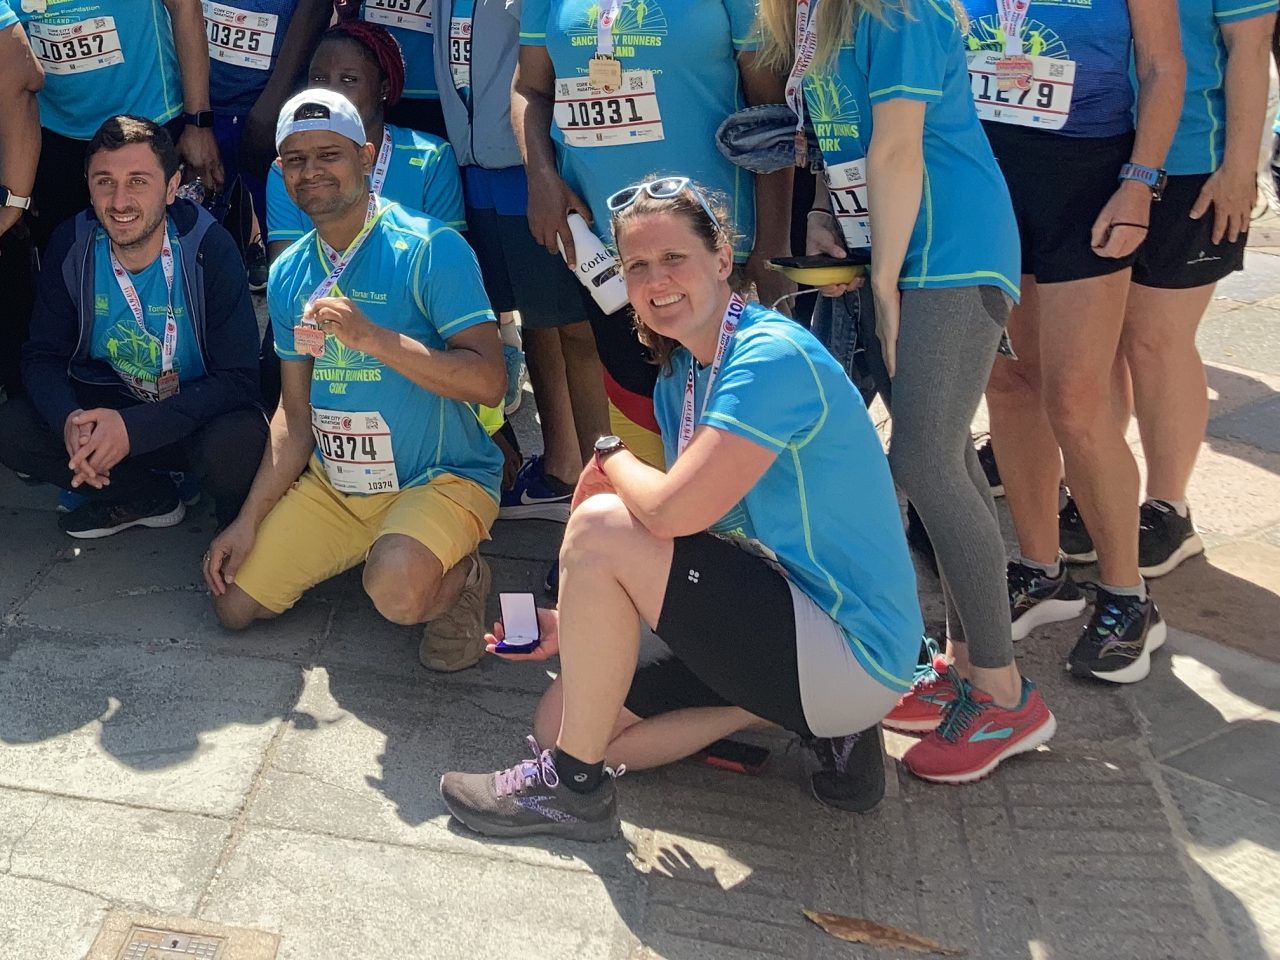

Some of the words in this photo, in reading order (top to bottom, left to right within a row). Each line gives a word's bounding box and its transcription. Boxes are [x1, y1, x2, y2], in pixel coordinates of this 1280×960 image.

[40, 34, 105, 61] 10357
[622, 34, 662, 46] RUNNERS
[568, 98, 643, 127] 10331
[819, 137, 841, 152] ORK
[580, 254, 607, 274] Cork
[345, 369, 381, 381] RUNNERS
[328, 383, 347, 395] CORK
[316, 431, 377, 461] 10374
[368, 480, 393, 490] 10374
